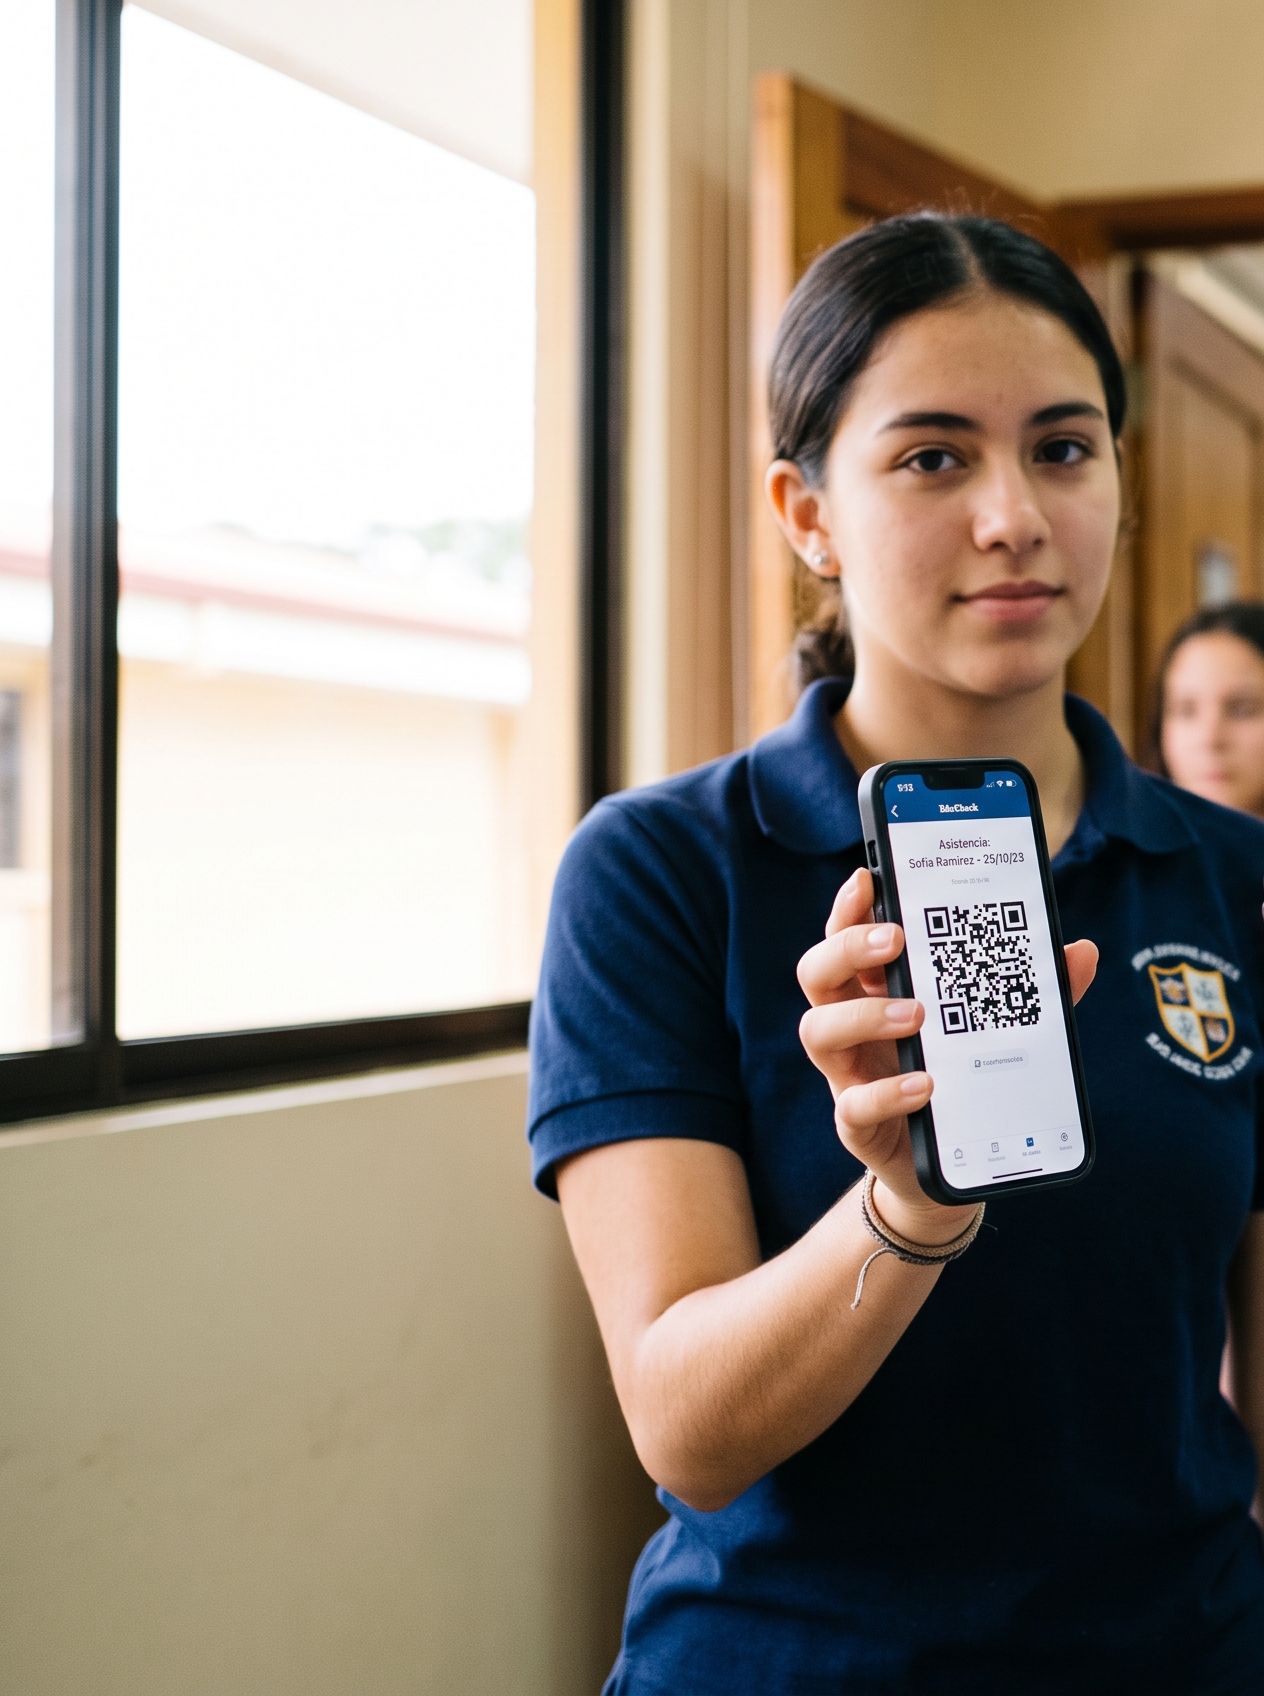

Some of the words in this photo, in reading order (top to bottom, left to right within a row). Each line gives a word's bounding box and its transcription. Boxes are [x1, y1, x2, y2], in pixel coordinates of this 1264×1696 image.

[939, 837, 991, 850] Asistencia:
[908, 857, 934, 869] Sofia
[936, 855, 975, 868] Ramirez
[983, 852, 1025, 866] 25/10/23
